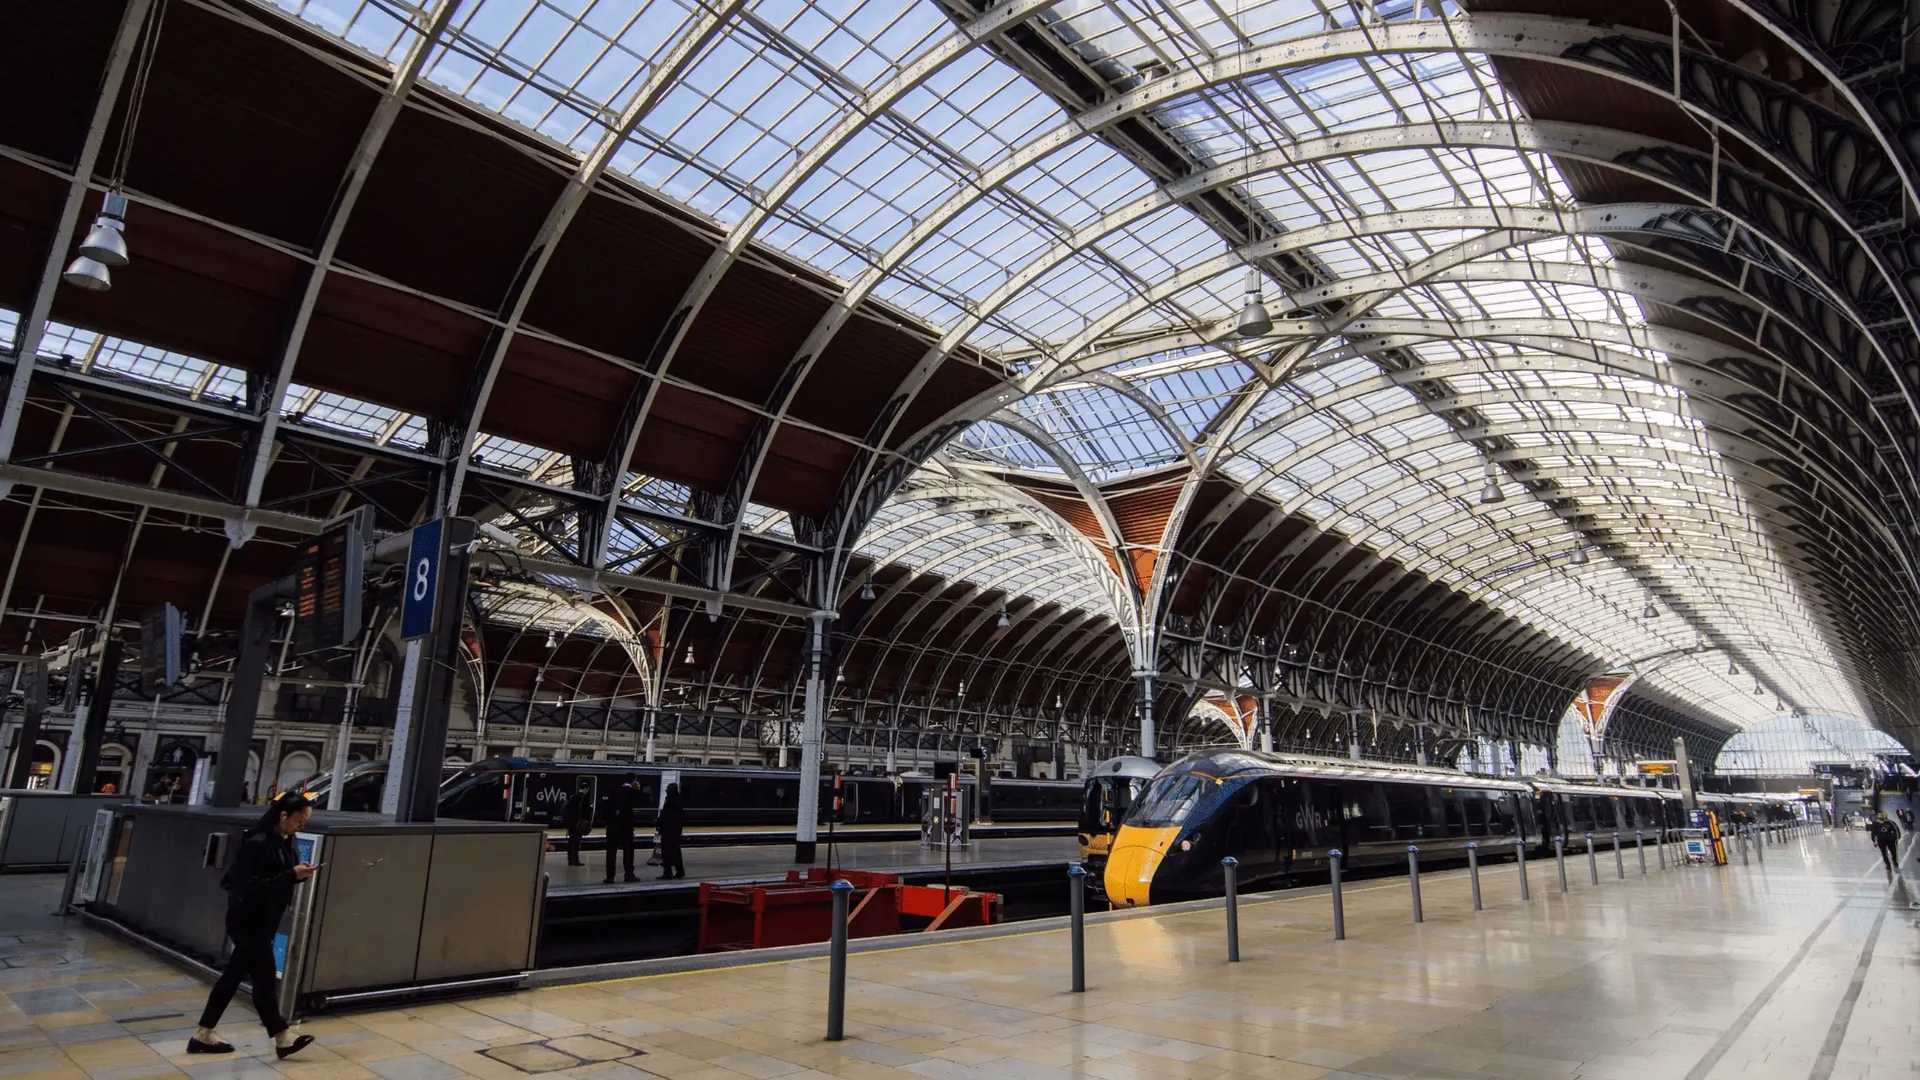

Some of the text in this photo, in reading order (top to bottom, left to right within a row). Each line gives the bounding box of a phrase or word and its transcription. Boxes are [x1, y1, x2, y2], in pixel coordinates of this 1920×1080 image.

[414, 558, 429, 601] 8
[536, 785, 568, 804] GWR
[1296, 800, 1322, 833] GWR
